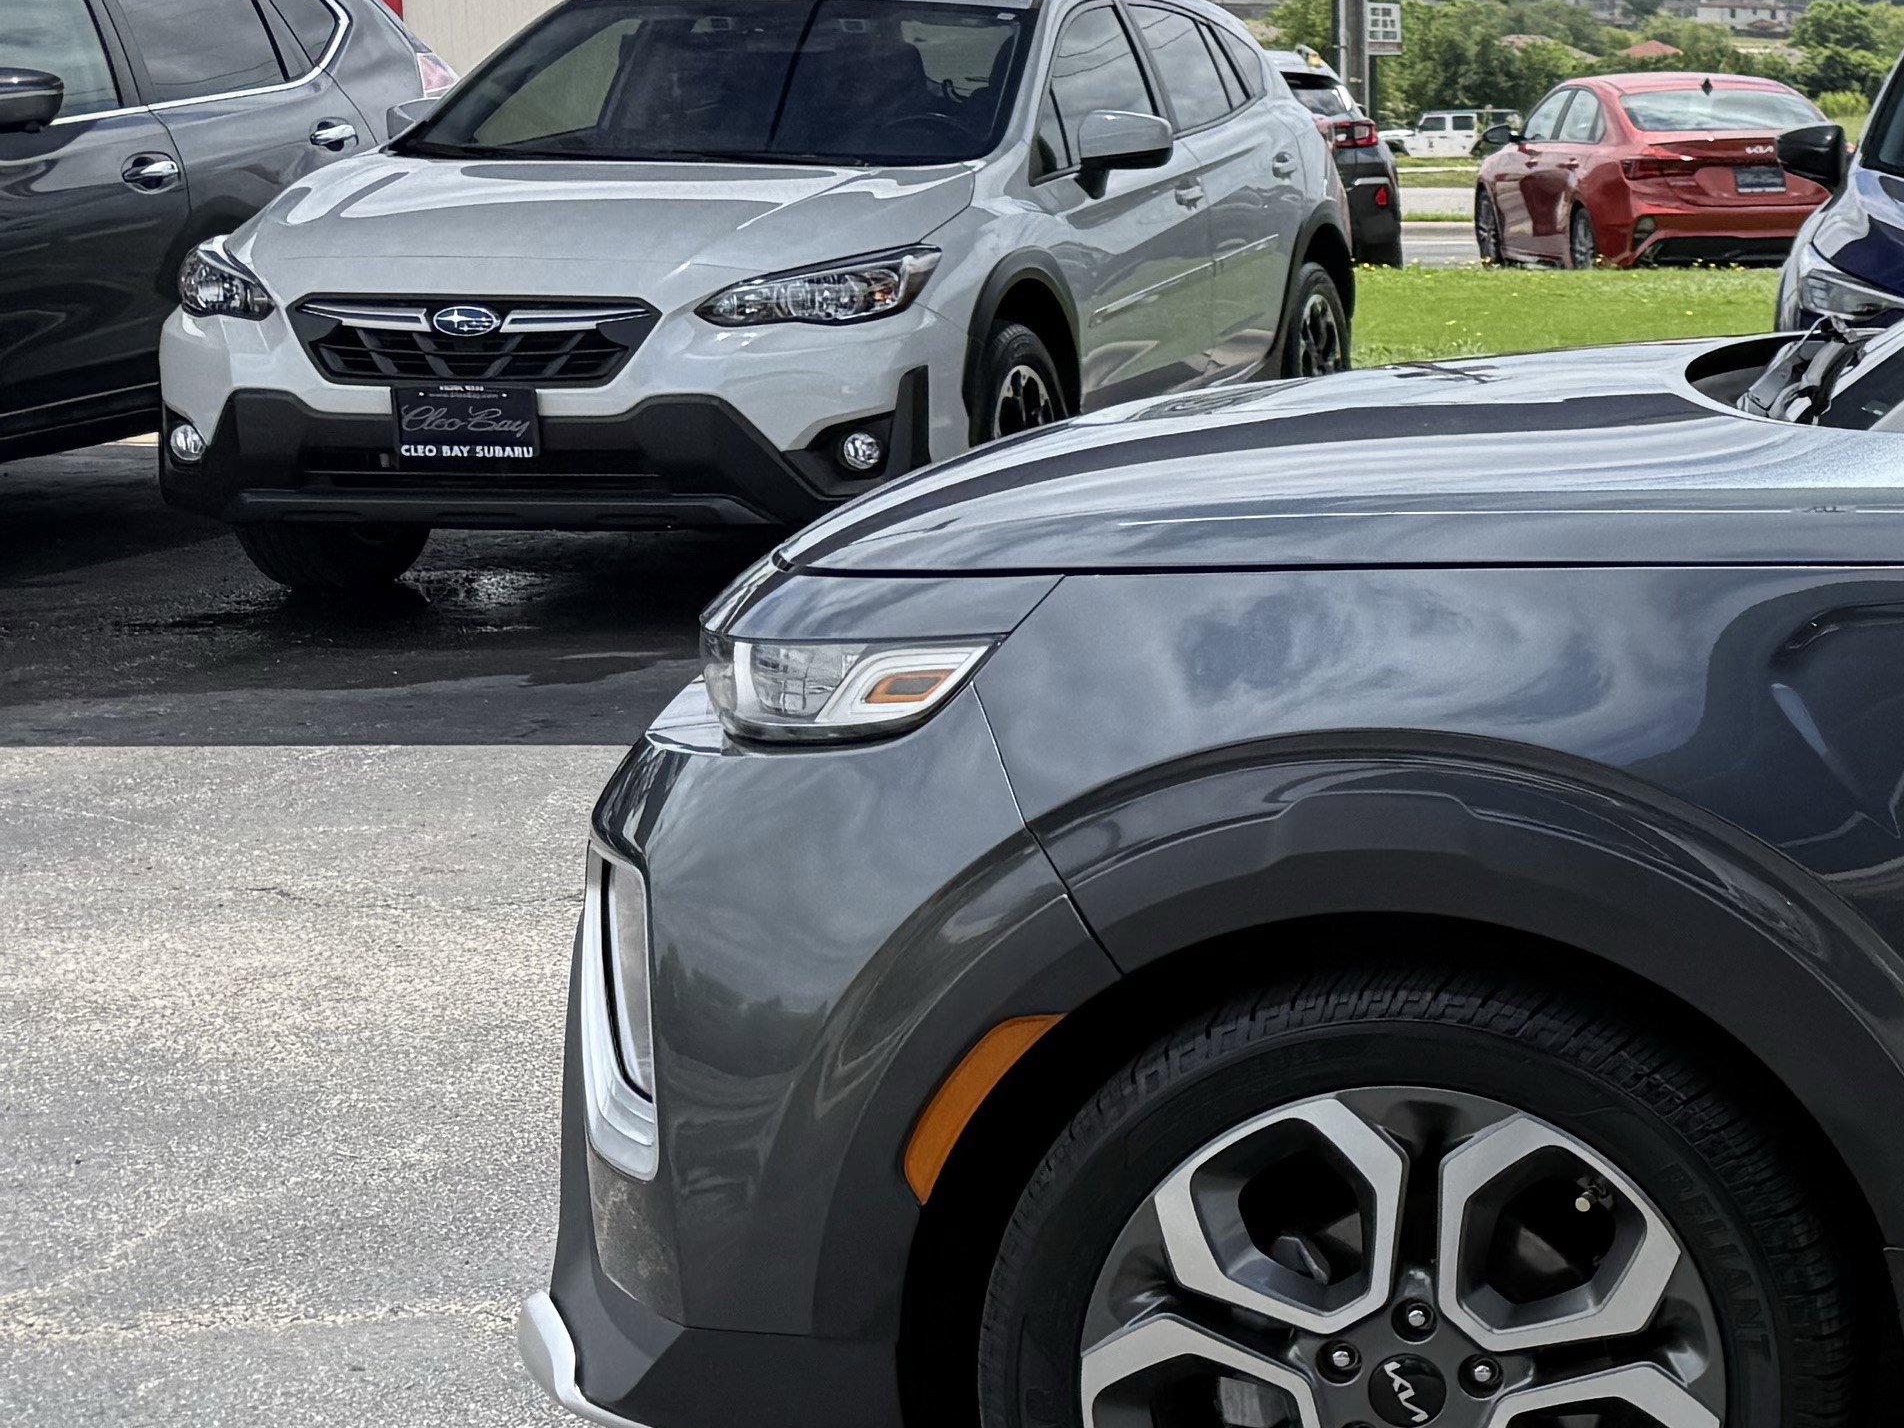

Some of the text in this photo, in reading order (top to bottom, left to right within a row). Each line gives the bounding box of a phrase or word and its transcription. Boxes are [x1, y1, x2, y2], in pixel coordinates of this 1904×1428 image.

[401, 405, 531, 438] Cleo Bay
[401, 444, 533, 458] CLEO BAY SUBARU
